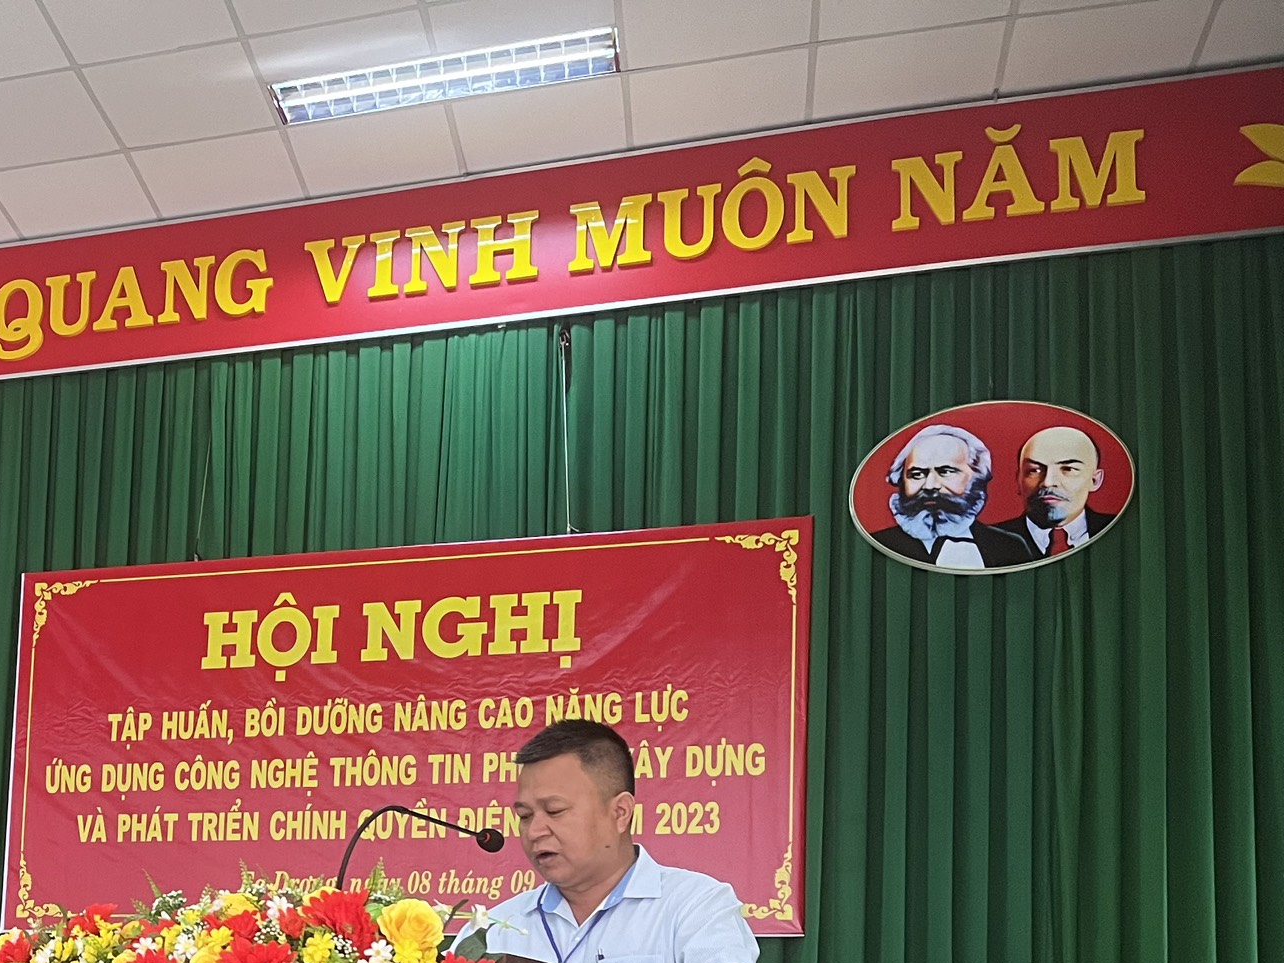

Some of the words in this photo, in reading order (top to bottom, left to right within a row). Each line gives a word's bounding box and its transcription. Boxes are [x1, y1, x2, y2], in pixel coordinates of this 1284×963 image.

[304, 209, 540, 305] VINH
[568, 156, 857, 276] MUÔN
[891, 123, 1147, 235] NĂM
[201, 592, 341, 682] HỘI
[360, 589, 583, 669] NGHỊ
[108, 706, 153, 750] TẬP
[161, 699, 234, 745] HUẤN,
[244, 697, 287, 737] BỒI
[295, 697, 383, 735] DƯỠNG
[394, 694, 467, 732] NÂNG
[478, 696, 534, 729] CAO
[634, 684, 689, 732] LỰC
[45, 757, 92, 794] ỨNG
[101, 762, 165, 801] DỤNG
[174, 754, 240, 791] CÔNG
[250, 751, 319, 797] NGHỆ
[329, 749, 417, 787] THÔNG
[428, 753, 471, 784] TIN
[628, 740, 674, 779] ÂY
[685, 737, 766, 786] DỰNG
[77, 807, 107, 843] VÀ
[117, 806, 179, 843] PHÁT
[188, 798, 259, 842] TRIỂN
[269, 803, 347, 841] CHÍNH
[357, 798, 448, 842] QUYỀN
[654, 801, 721, 835] 2023
[407, 870, 432, 894] 08
[438, 869, 504, 900] tháng
[510, 869, 536, 894] 09
